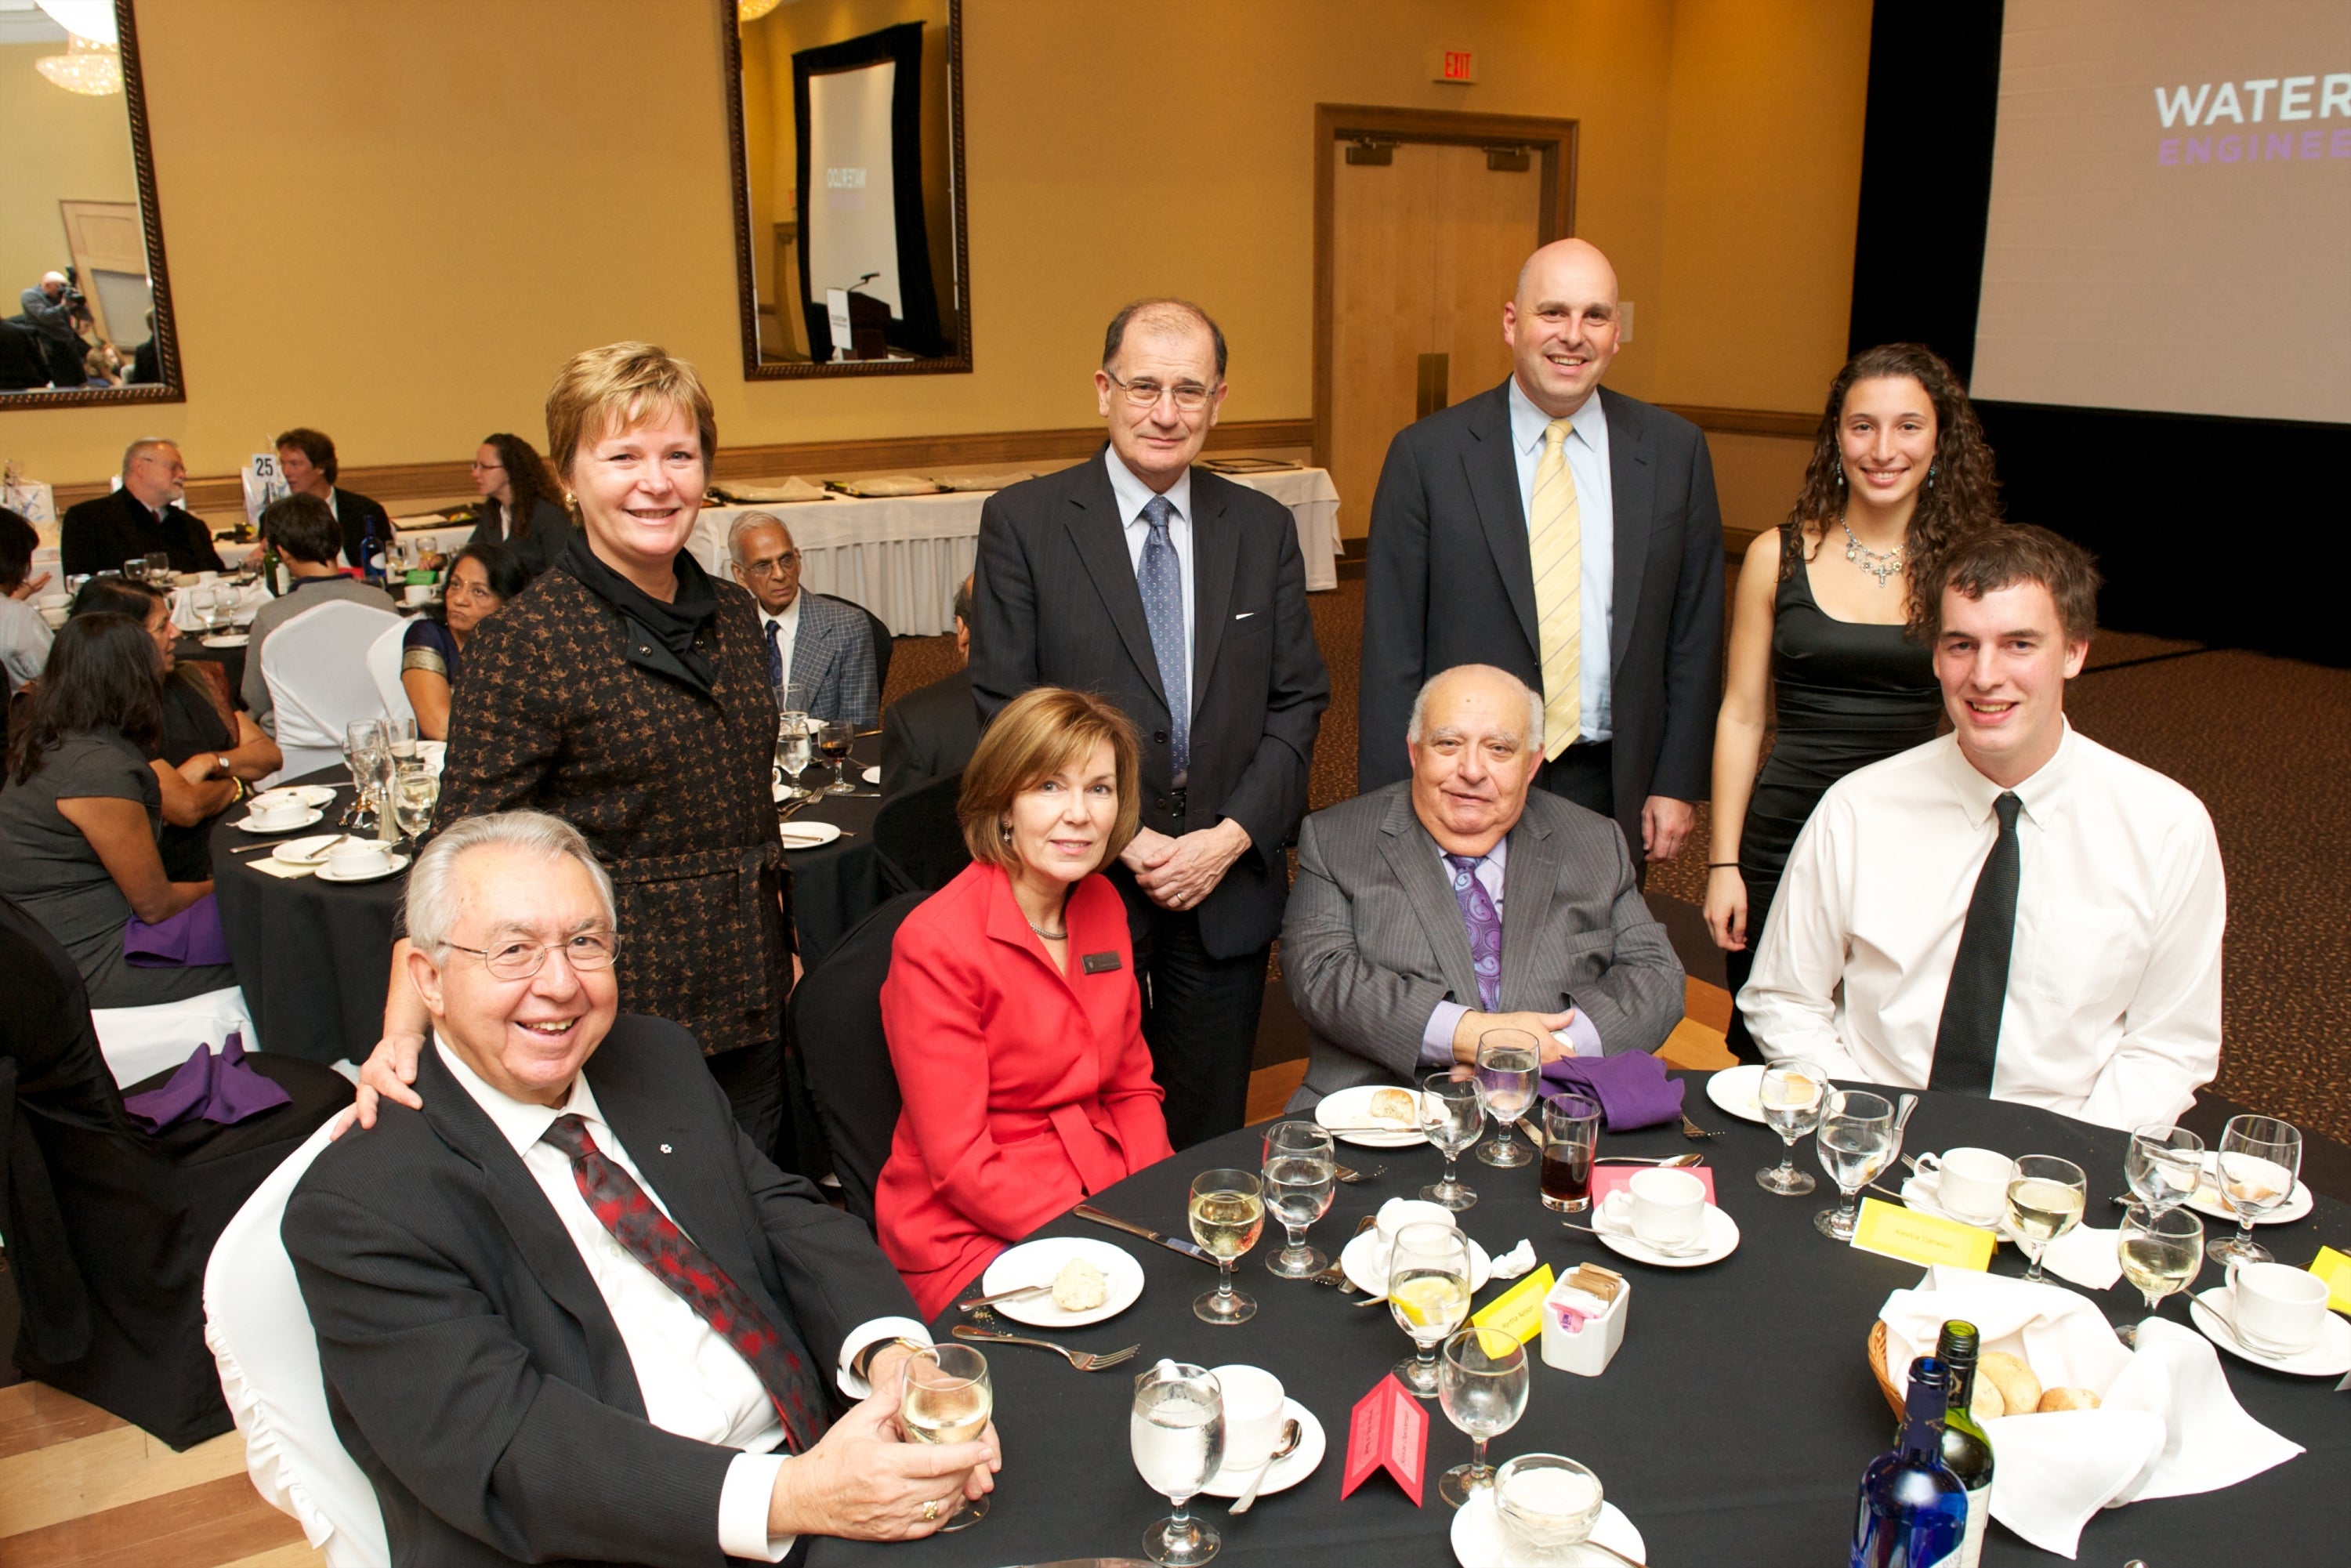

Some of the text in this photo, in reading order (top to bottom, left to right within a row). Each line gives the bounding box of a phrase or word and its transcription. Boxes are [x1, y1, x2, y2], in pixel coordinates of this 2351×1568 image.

[1444, 52, 1470, 78] EXIT
[2155, 72, 2351, 129] WATER
[2159, 129, 2351, 166] ENGINEE
[255, 458, 273, 476] 25
